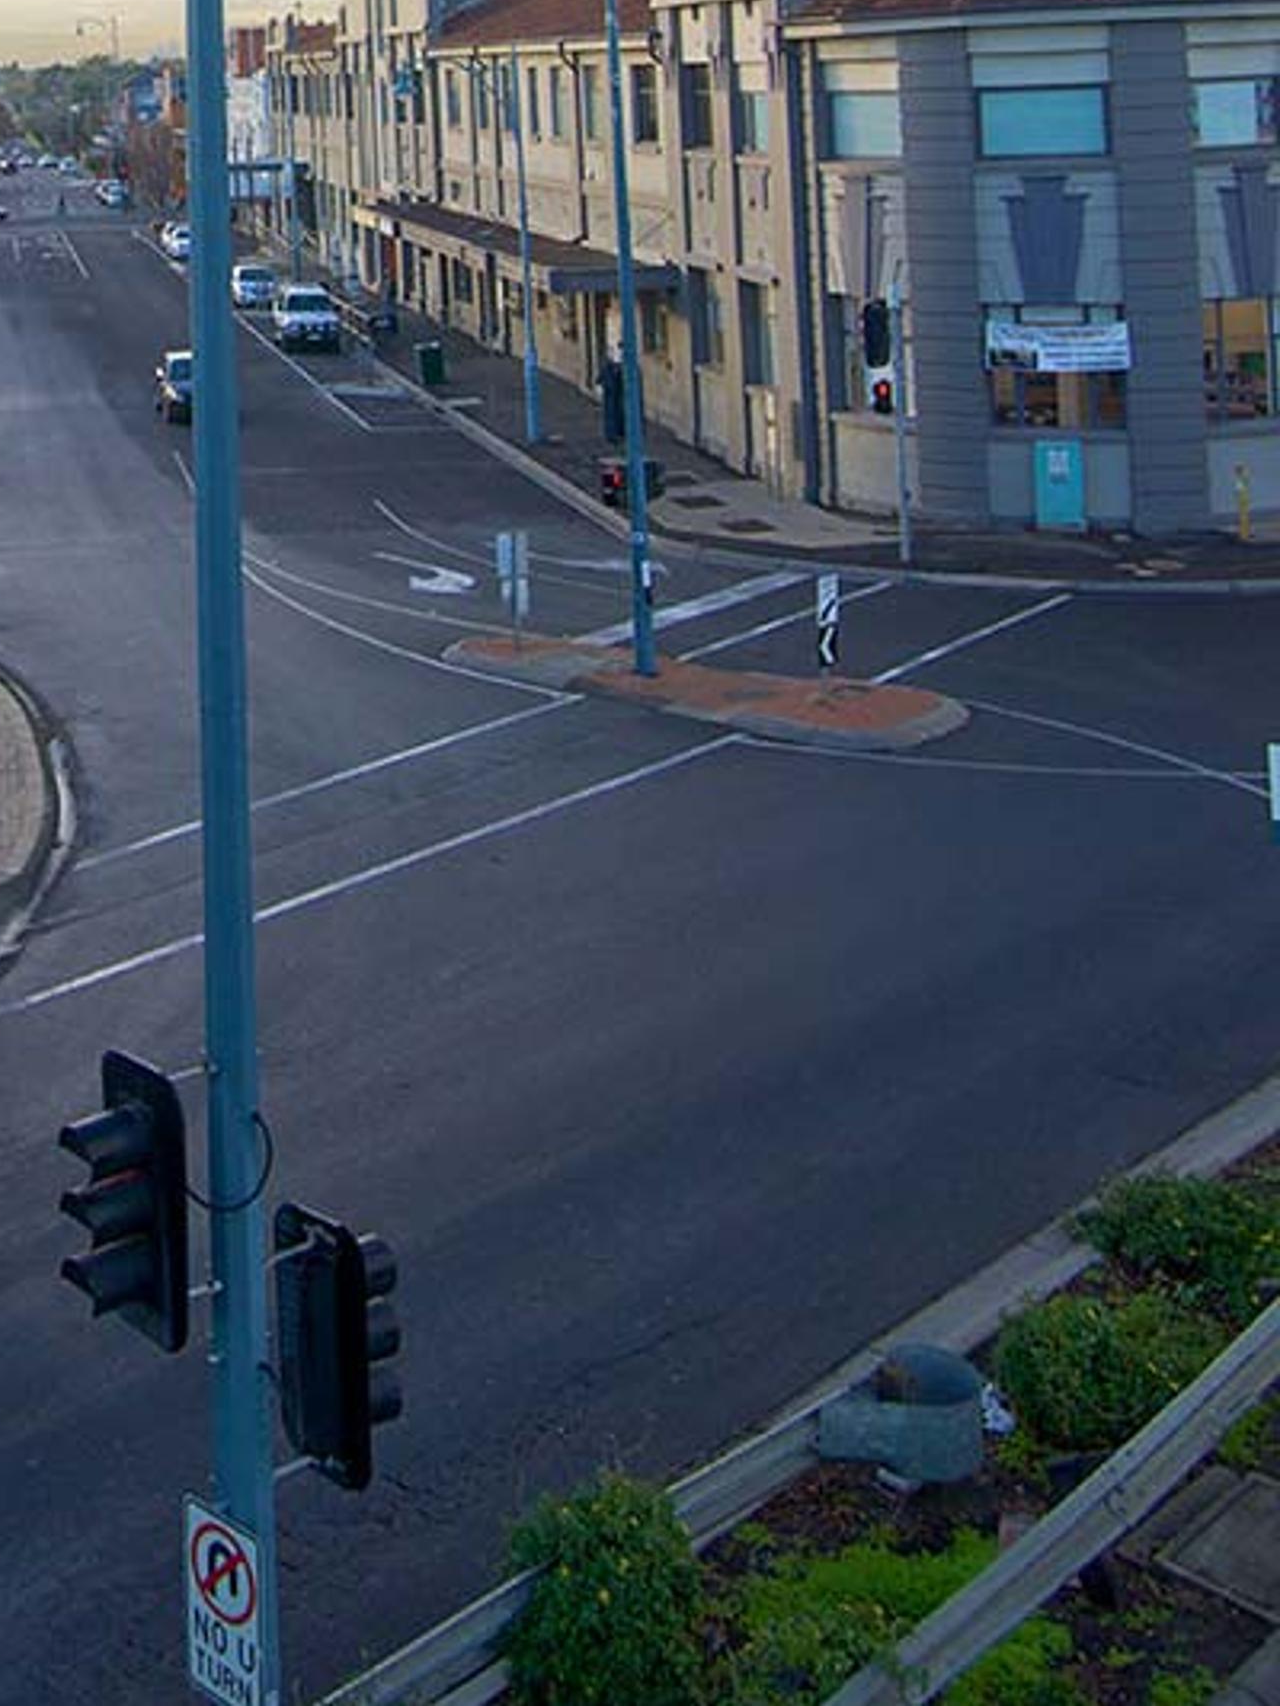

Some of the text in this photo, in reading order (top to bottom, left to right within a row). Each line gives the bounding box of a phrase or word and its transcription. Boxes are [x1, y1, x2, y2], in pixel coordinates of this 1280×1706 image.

[194, 1606, 256, 1674] NO U
[196, 1646, 252, 1706] TURN
